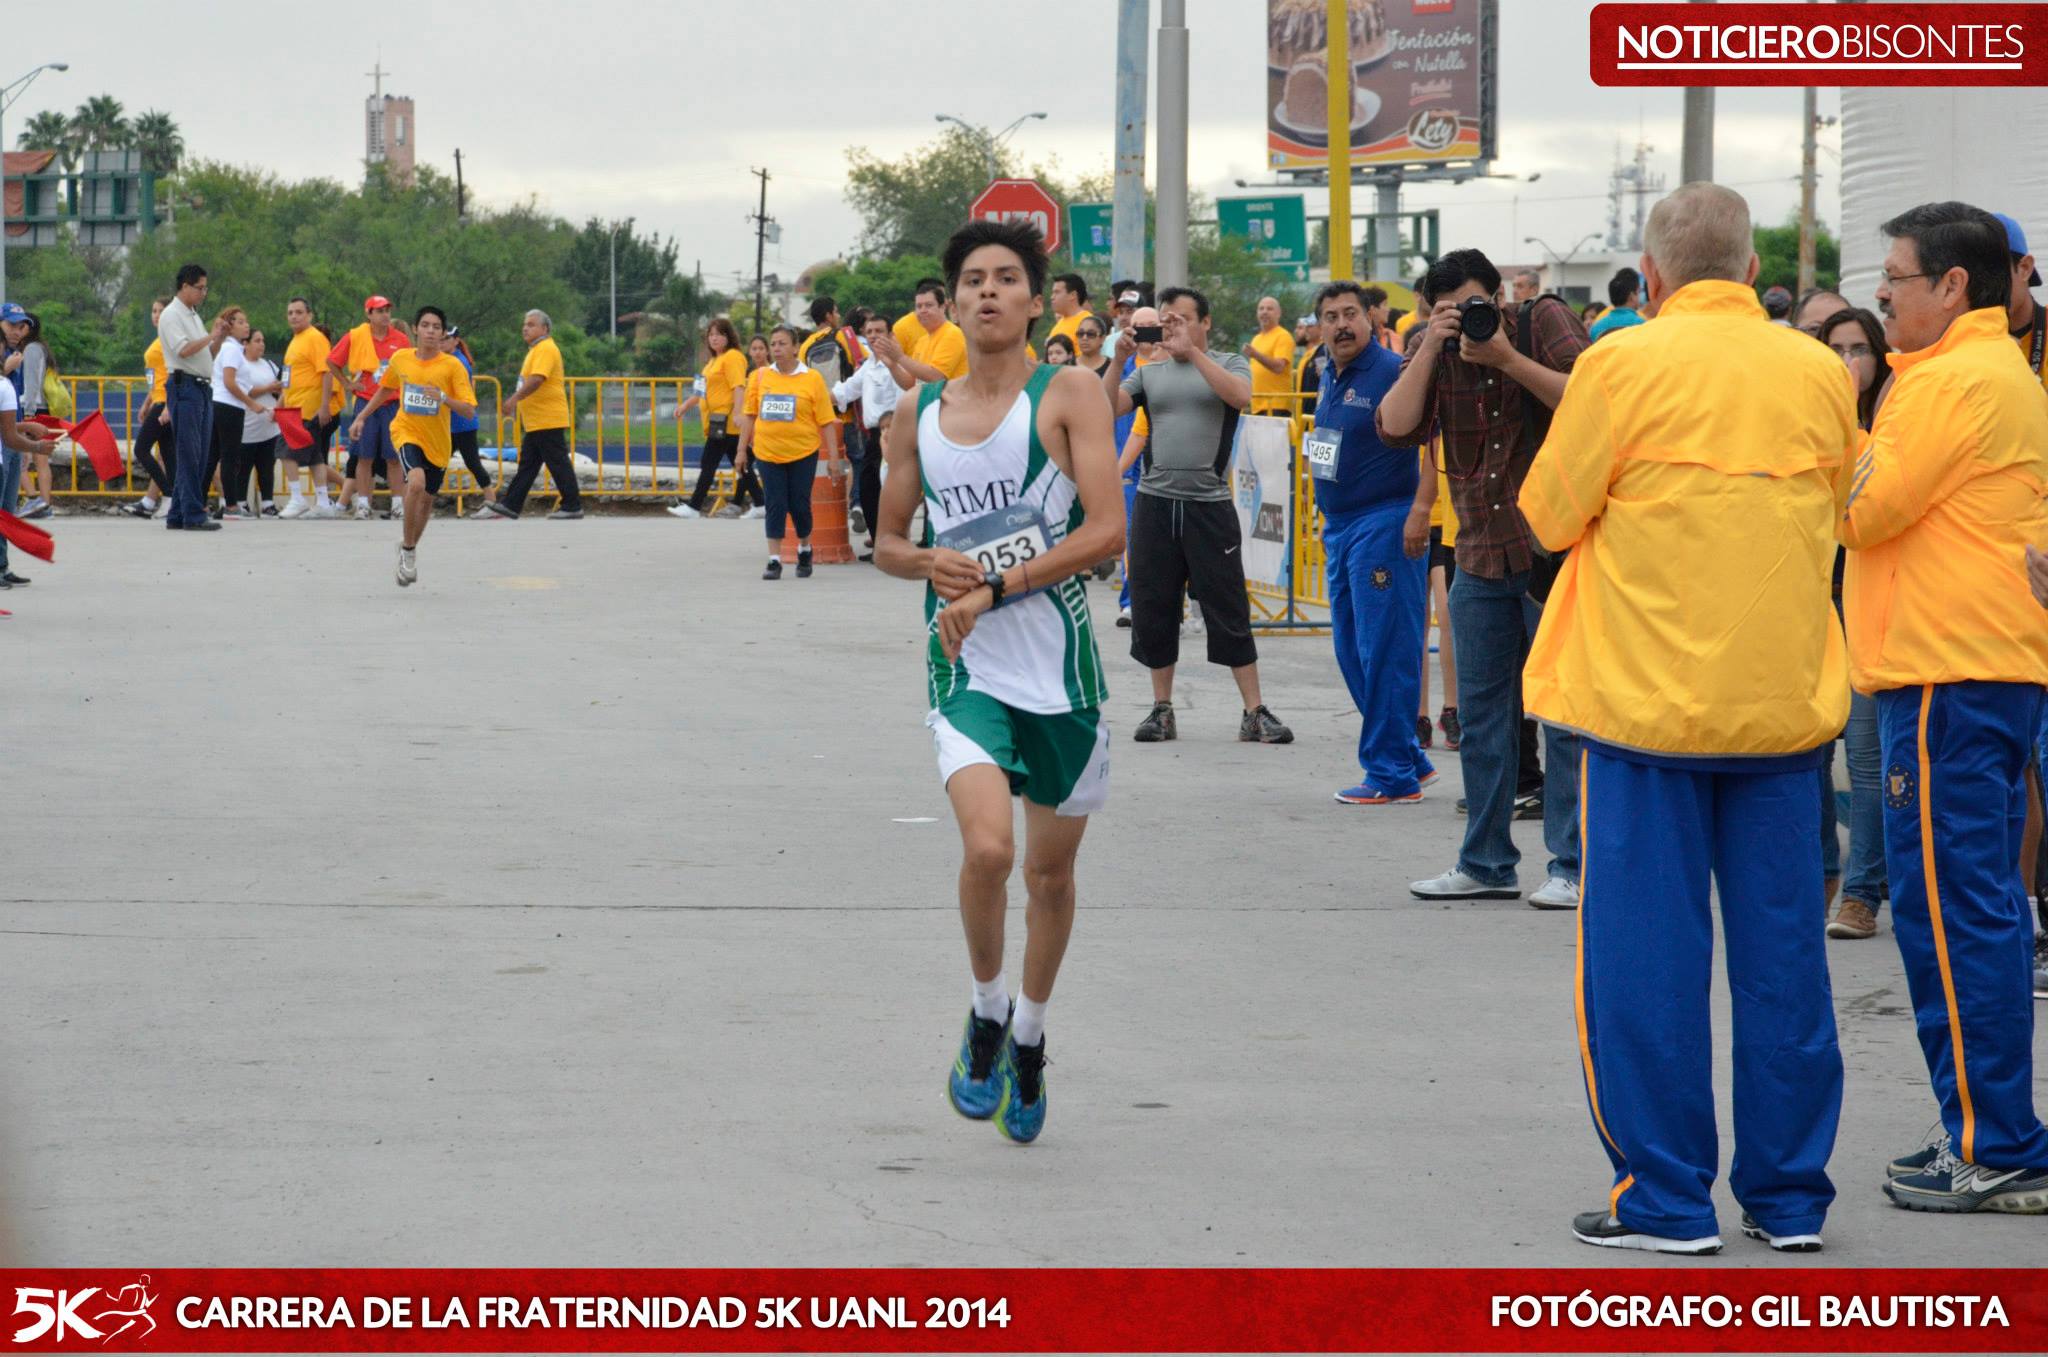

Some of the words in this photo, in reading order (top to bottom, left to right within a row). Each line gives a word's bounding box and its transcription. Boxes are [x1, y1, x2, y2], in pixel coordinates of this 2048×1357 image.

[1387, 26, 1475, 50] Tentación
[1415, 50, 1467, 72] Nutella
[1408, 111, 1453, 148] Lety
[766, 402, 790, 412] 2902
